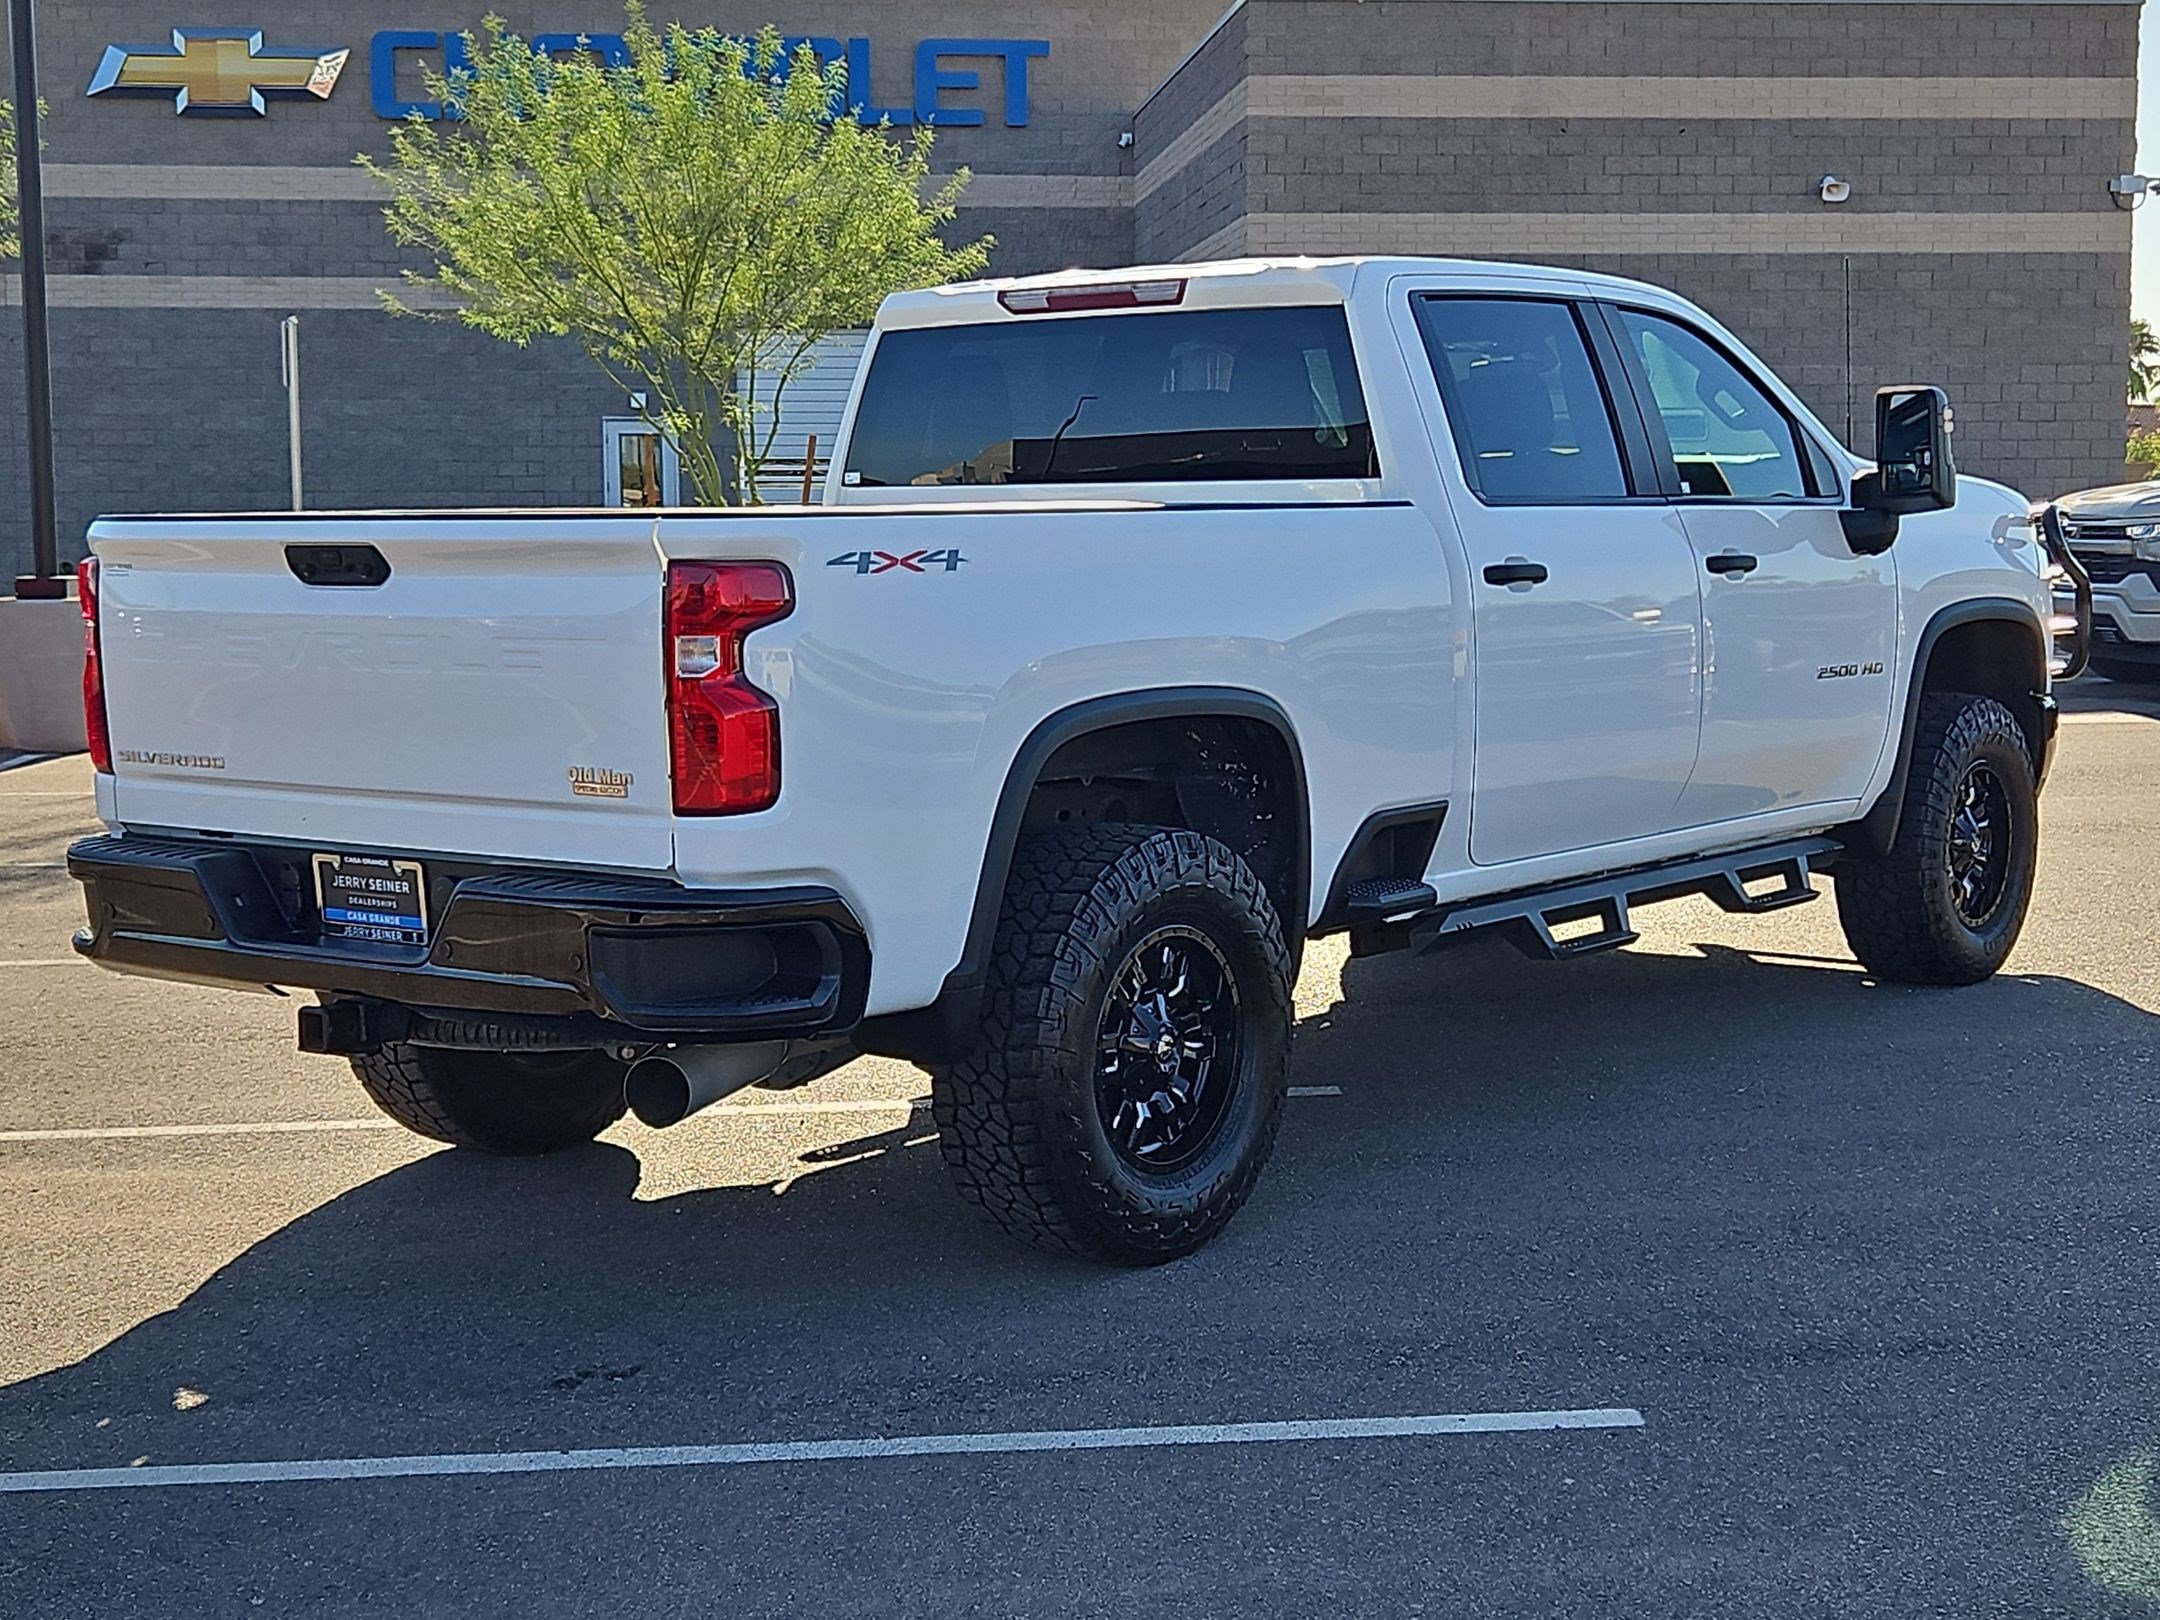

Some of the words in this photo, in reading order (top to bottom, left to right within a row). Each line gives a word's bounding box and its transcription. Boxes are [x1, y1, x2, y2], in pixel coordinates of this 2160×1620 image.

[1816, 664, 1858, 680] 2500
[1861, 662, 1884, 676] HD
[117, 749, 226, 769] SILVERADO
[567, 765, 594, 784] Old
[595, 767, 634, 786] Man
[344, 856, 361, 864] CASA
[332, 874, 367, 890] JERRY
[368, 878, 411, 894] SEINER
[348, 896, 397, 909] DEALERSHIPS
[346, 912, 367, 922] CASA
[368, 913, 400, 925] GRANDE
[343, 927, 370, 937] JERRY
[370, 929, 402, 940] SEINER
